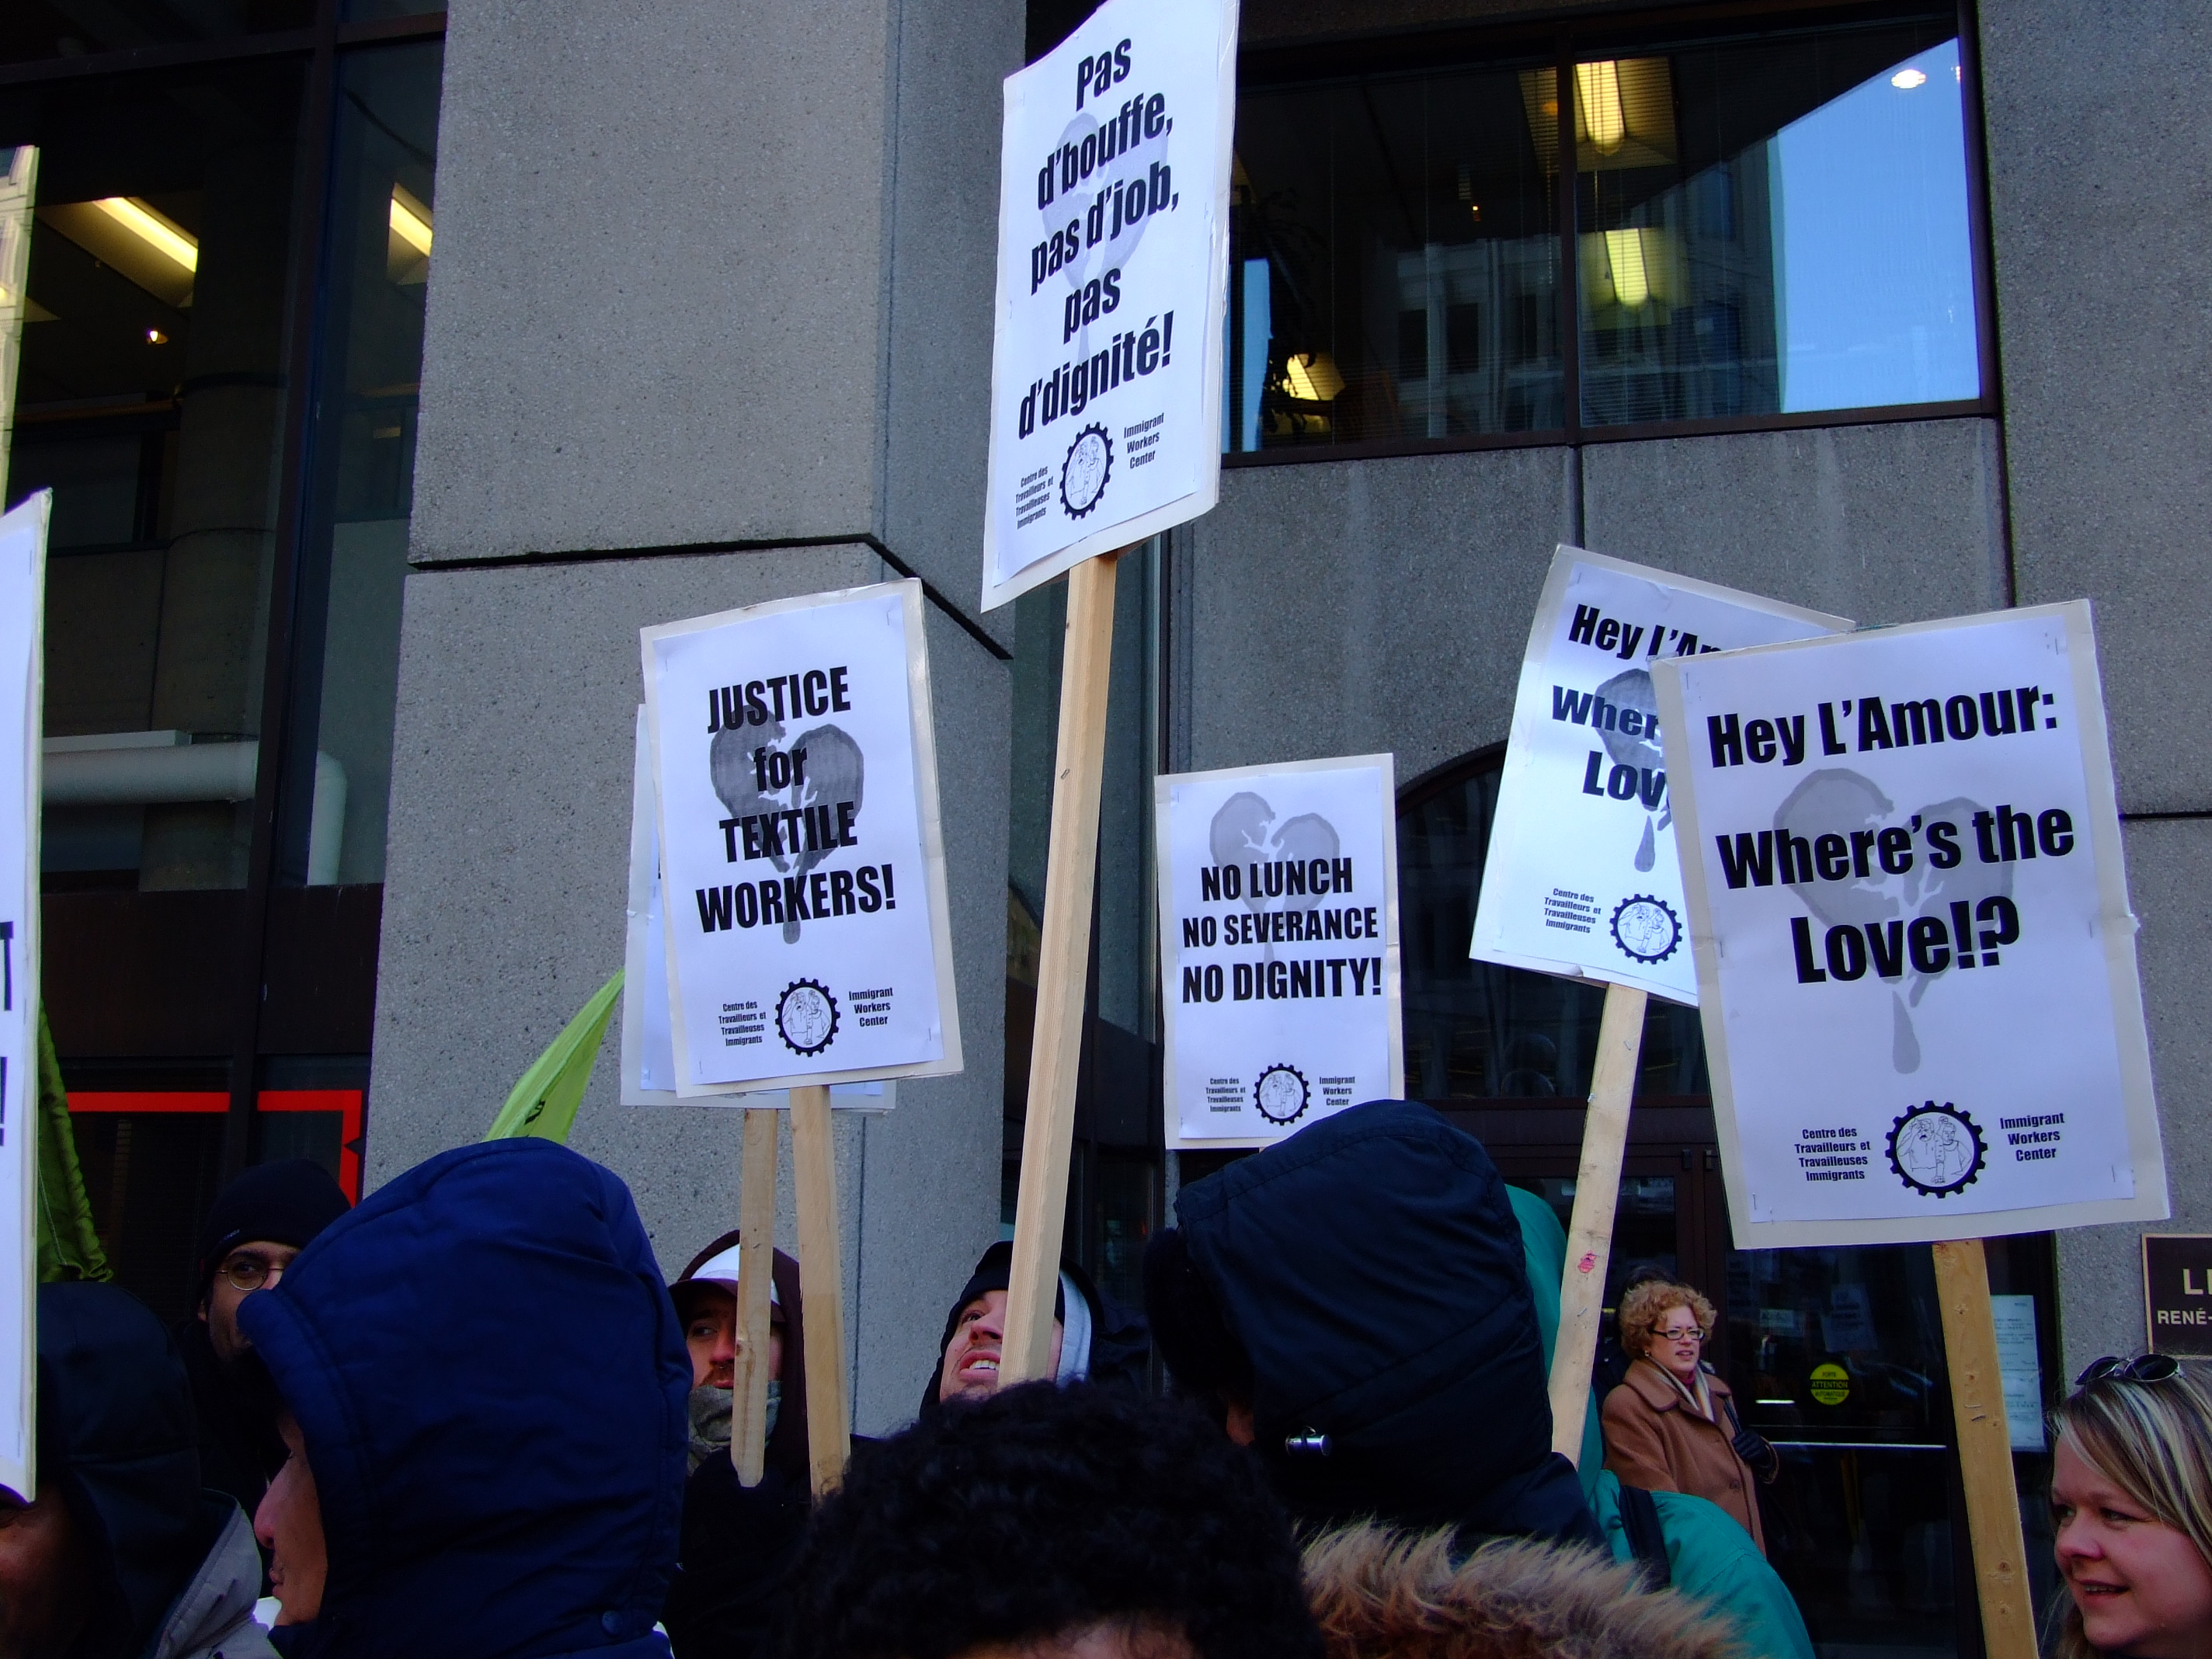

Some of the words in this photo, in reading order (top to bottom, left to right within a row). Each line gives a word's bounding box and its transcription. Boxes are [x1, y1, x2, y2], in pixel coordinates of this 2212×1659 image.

[1076, 38, 1132, 112] Pas
[1037, 92, 1174, 210] d'bouffe,
[1030, 214, 1080, 296] pas
[1086, 160, 1180, 245] d'job,
[1063, 267, 1121, 344] pas
[1017, 311, 1174, 440] d'dignité!
[1123, 412, 1164, 439] Immigrant
[1126, 432, 1160, 454] Workers
[1129, 450, 1156, 469] Center
[1021, 471, 1038, 488] Centre
[1038, 466, 1048, 478] des
[1015, 481, 1046, 504] Travailleurs
[1017, 507, 1047, 530] Immigrants
[1567, 603, 1644, 660] Hey
[1647, 624, 1722, 656] L'A
[707, 666, 851, 734] JUSTICE
[1552, 684, 1659, 740] Wher
[1707, 712, 1805, 768] Hey
[1818, 683, 2058, 756] L'Amour:
[753, 746, 808, 791] for
[1582, 750, 1671, 809] Lov
[718, 801, 857, 863] TEXTILE
[1715, 814, 1962, 890] Where's
[1971, 804, 2075, 864] the
[1201, 864, 1241, 901] NO
[1250, 857, 1352, 899] LUNCH
[696, 864, 896, 934] WORKERS!
[1544, 896, 1591, 913] Travailleurs
[1553, 888, 1579, 899] Centre
[1580, 893, 1595, 903] des
[1544, 907, 1596, 923] Travailleuses
[1182, 915, 1217, 948] NO
[1223, 906, 1378, 945] SEVERANCE
[1546, 919, 1591, 934] Immigrants
[1790, 896, 2020, 984] Love!?
[1182, 964, 1223, 1003] NO
[1233, 957, 1382, 1002] DIGNITY!
[848, 986, 893, 1001] Immigrant
[722, 1003, 745, 1012] Centre
[746, 1000, 757, 1010] des
[854, 1002, 891, 1014] Workers
[718, 1013, 758, 1024] Travailleurs
[760, 1011, 767, 1020] et
[859, 1016, 889, 1027] Center
[721, 1024, 765, 1035] Travailleuses
[725, 1035, 763, 1047] Immigrants
[1319, 1075, 1355, 1085] Immigrant
[1323, 1087, 1352, 1095] Workers
[1326, 1097, 1349, 1106] Center
[2000, 1112, 2065, 1129] Immigrant
[1802, 1129, 1837, 1139] Centre
[1838, 1127, 1858, 1138] des
[2007, 1131, 2061, 1146] Workers
[1794, 1142, 1856, 1154] Travailleurs
[1860, 1140, 1871, 1150] et
[2015, 1148, 2057, 1162] Center
[1798, 1156, 1868, 1167] Travailleuses
[1805, 1170, 1866, 1181] Immigrants
